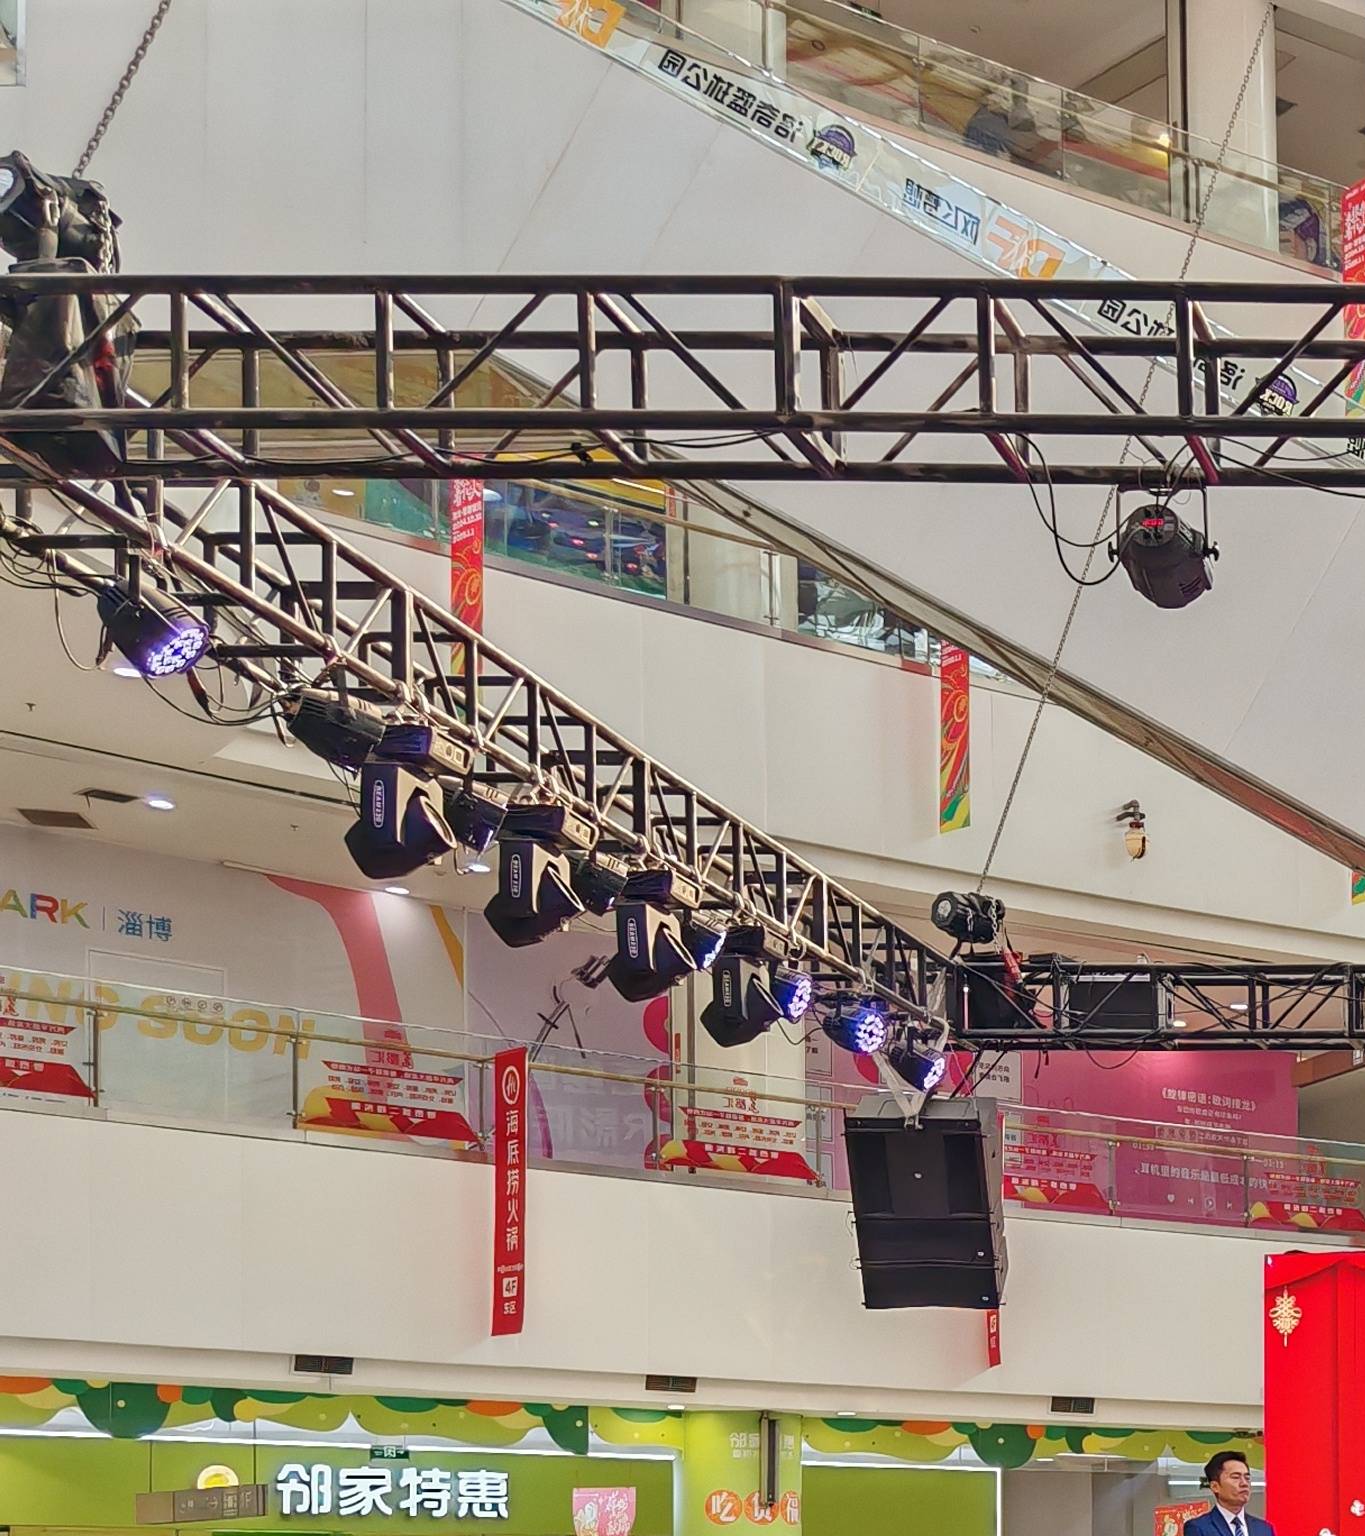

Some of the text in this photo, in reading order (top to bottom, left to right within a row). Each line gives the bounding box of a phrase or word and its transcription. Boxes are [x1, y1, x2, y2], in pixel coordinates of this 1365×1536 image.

[118, 908, 173, 942] 淄博
[505, 1109, 520, 1252] 海底捞火锅
[277, 1463, 510, 1519] 邻家特惠
